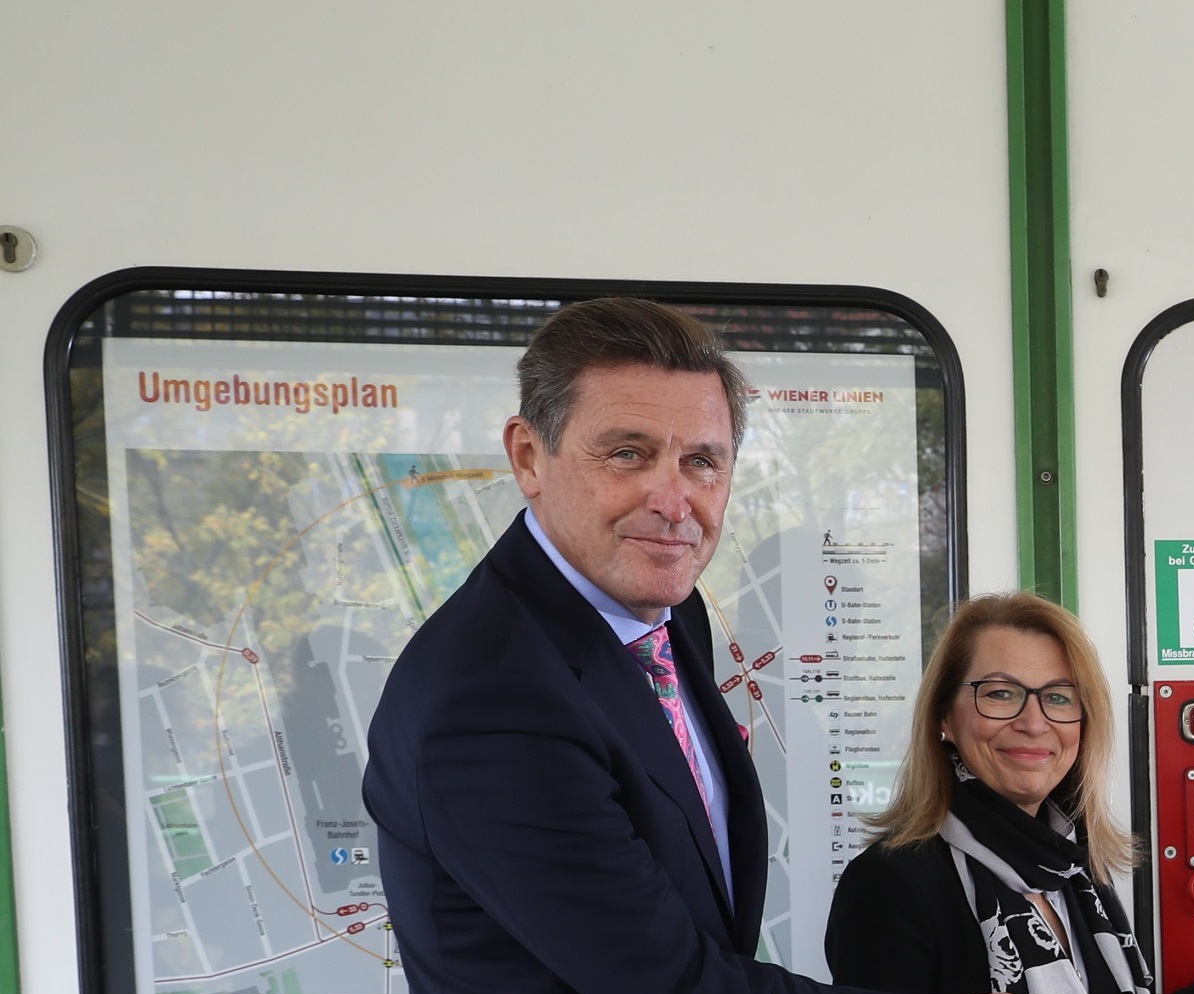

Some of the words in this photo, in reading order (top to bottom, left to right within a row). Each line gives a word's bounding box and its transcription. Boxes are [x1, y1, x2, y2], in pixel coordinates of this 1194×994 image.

[138, 371, 398, 415] Umgebungsplan
[768, 390, 829, 402] WIENER
[833, 391, 884, 403] LINIEN
[1168, 556, 1185, 565] bei
[274, 731, 292, 776] Althanstraße
[316, 820, 369, 828] Franz-Josefs-
[328, 831, 359, 839] Bahnhof
